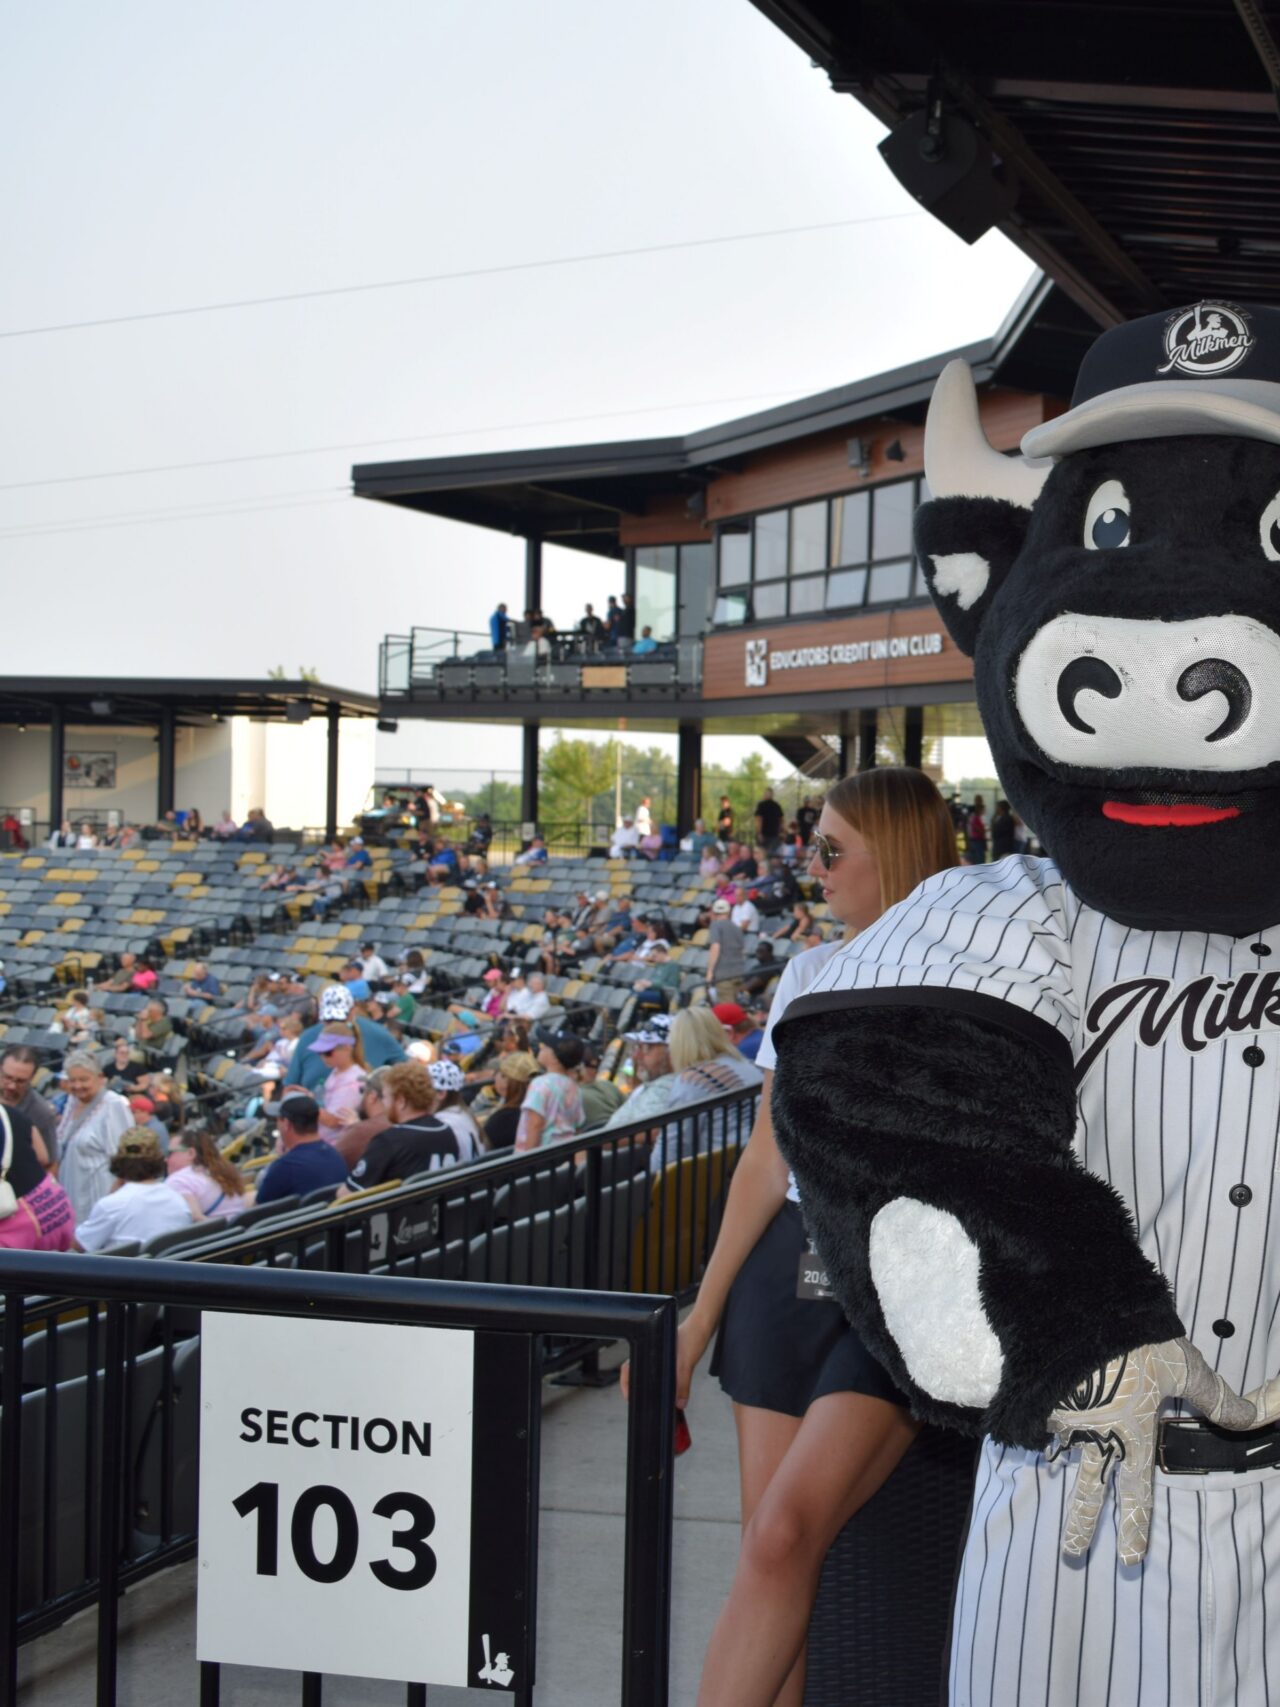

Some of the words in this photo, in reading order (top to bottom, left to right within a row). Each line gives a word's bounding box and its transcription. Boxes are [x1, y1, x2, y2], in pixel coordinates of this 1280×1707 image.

[1158, 334, 1254, 372] Milkmen
[770, 648, 829, 670] EDUCATORS
[830, 643, 869, 663] CREDIT
[910, 634, 942, 655] CLUB
[239, 1407, 432, 1457] SECTION
[231, 1481, 438, 1592] 103
